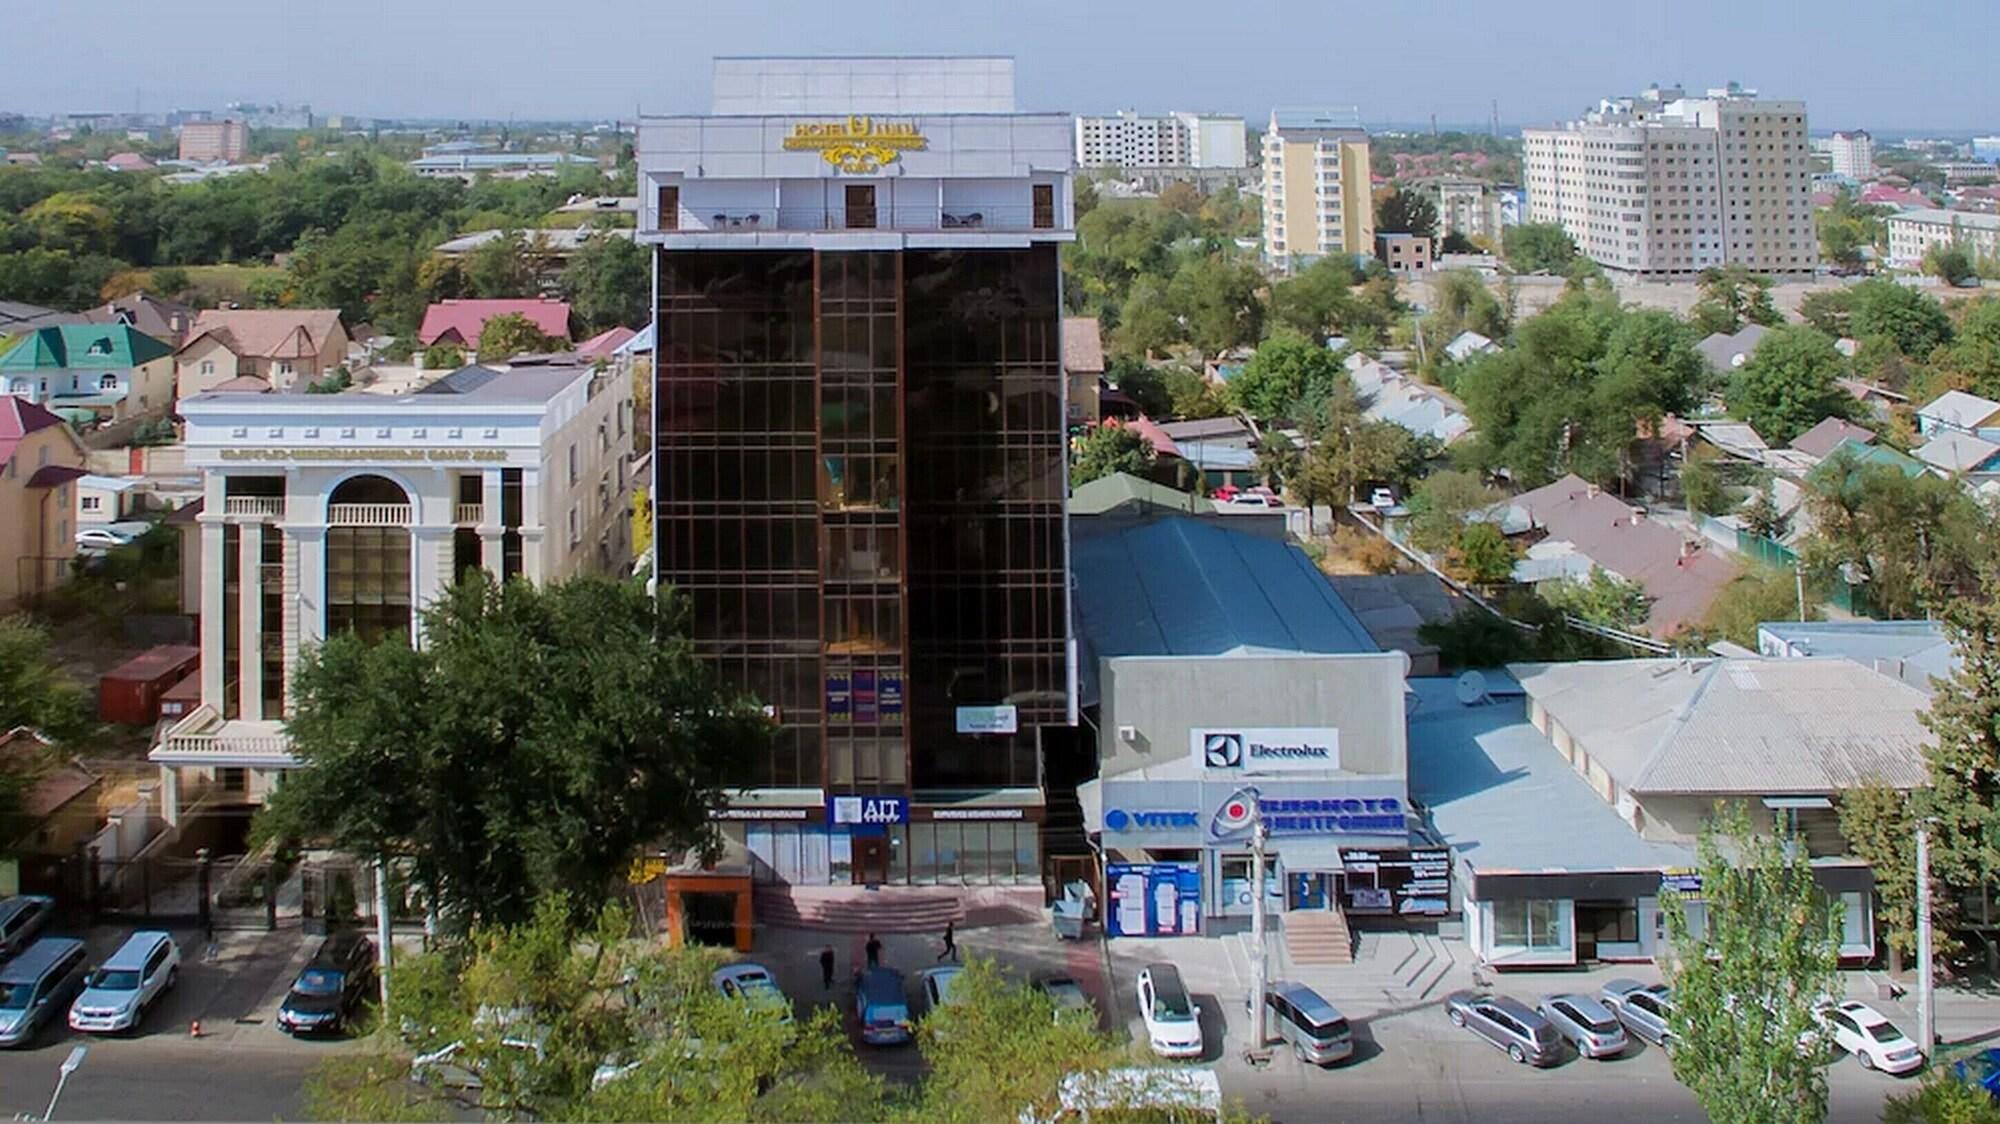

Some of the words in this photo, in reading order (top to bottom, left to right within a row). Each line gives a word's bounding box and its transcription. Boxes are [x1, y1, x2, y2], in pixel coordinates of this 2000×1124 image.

[1249, 743, 1329, 758] Electrolux
[864, 799, 900, 816] AIT
[1131, 810, 1200, 828] VITEK
